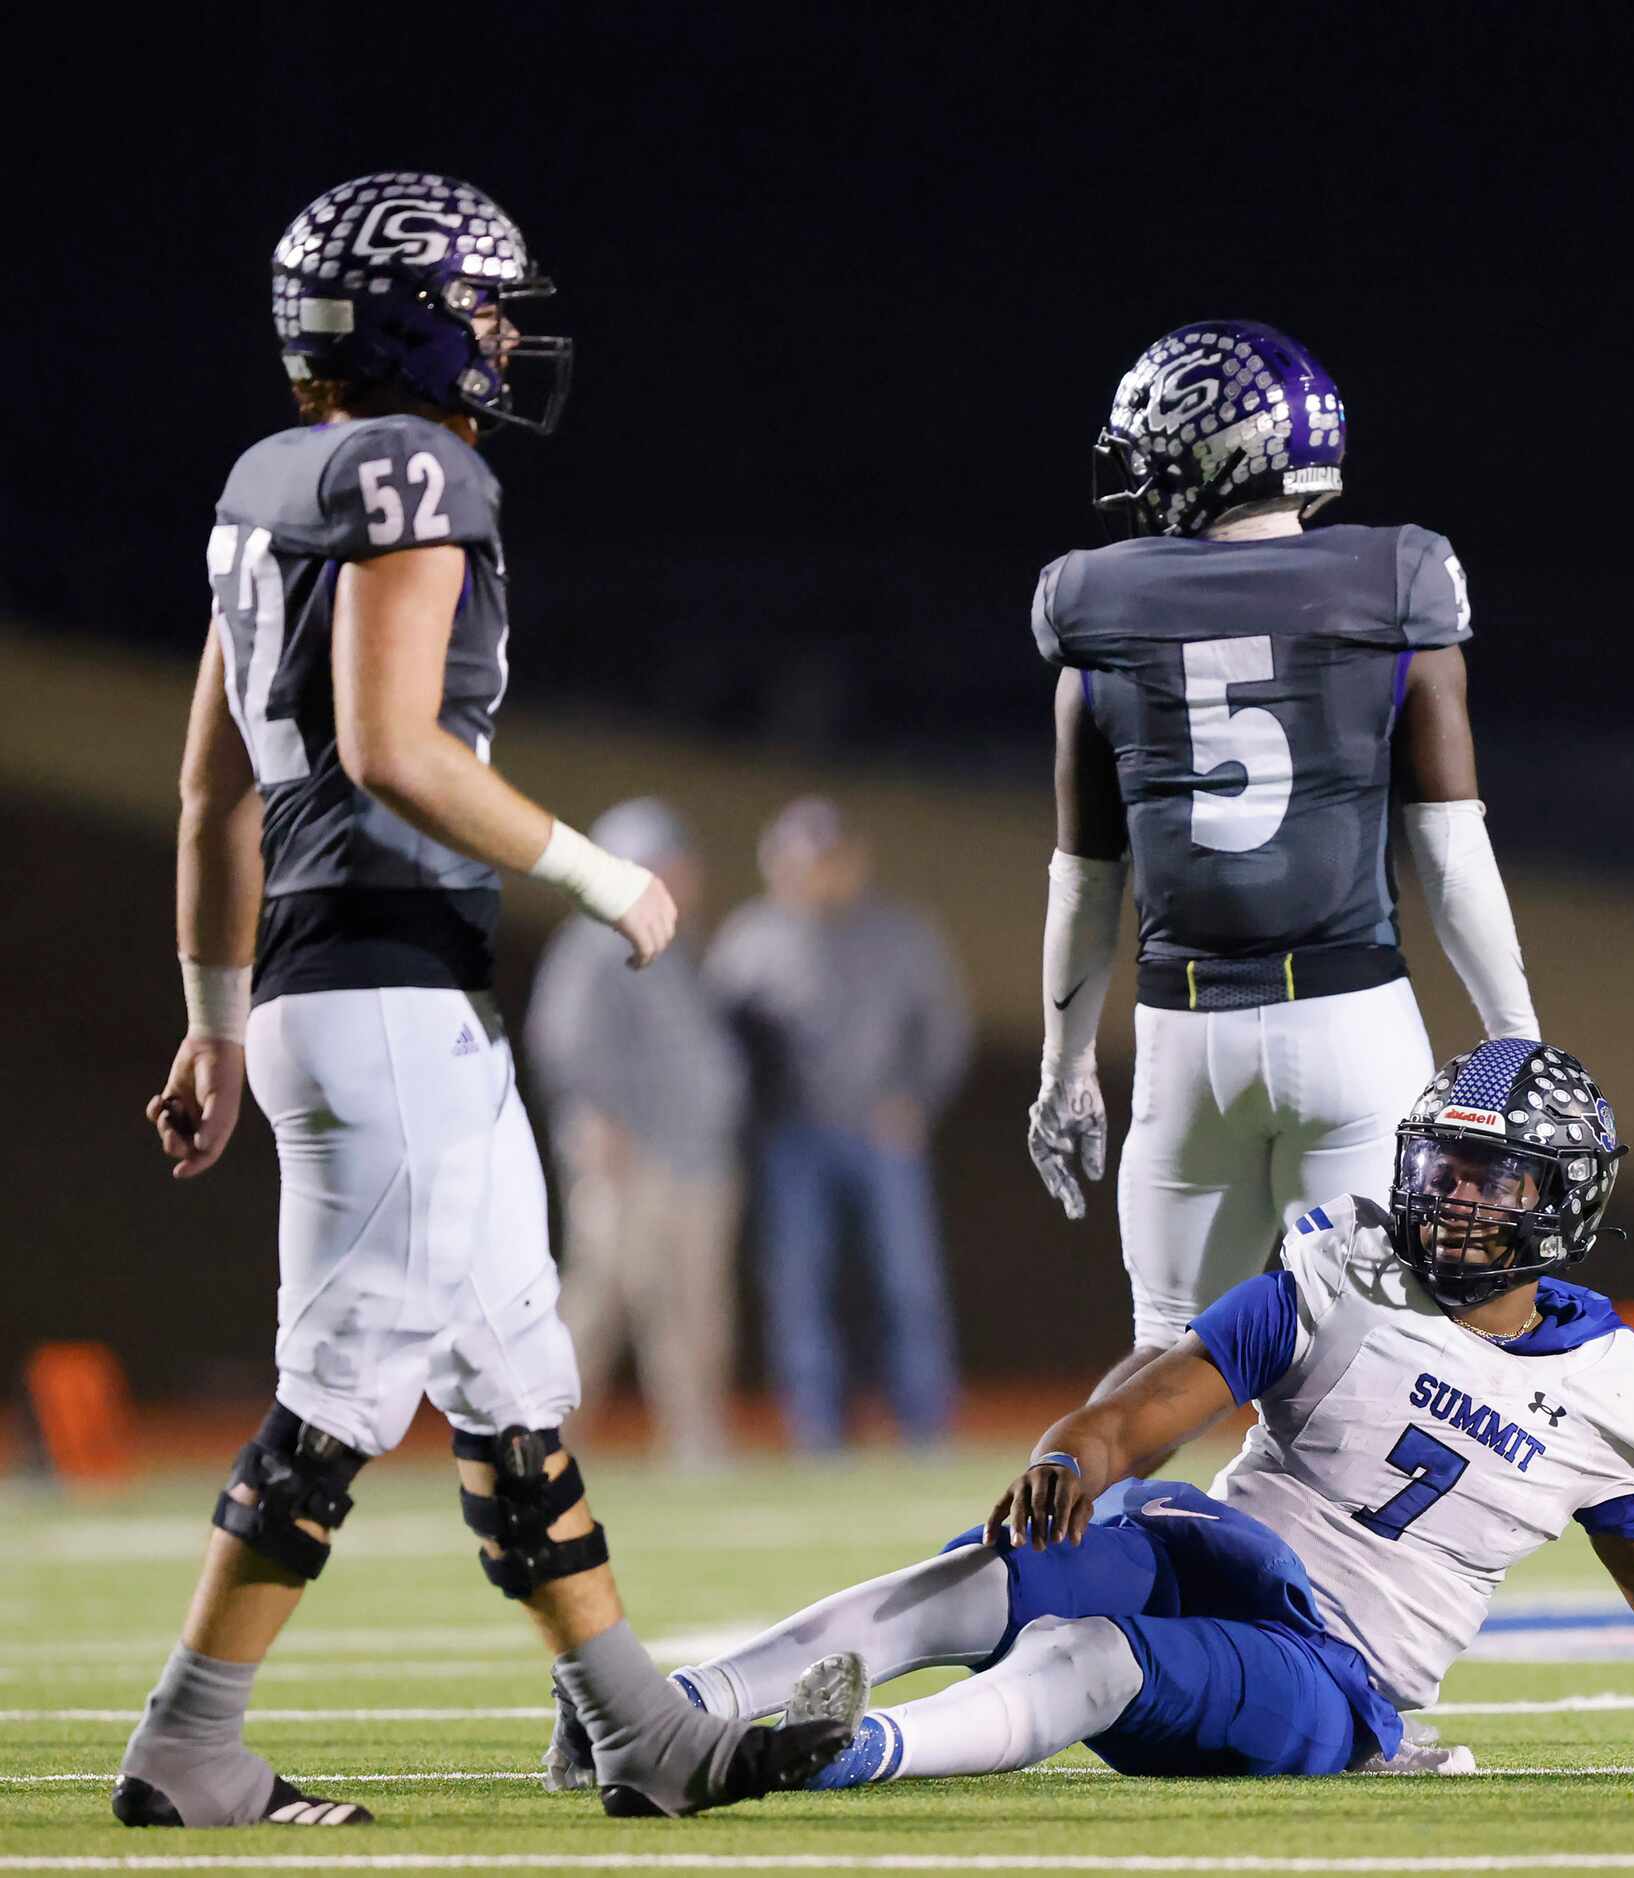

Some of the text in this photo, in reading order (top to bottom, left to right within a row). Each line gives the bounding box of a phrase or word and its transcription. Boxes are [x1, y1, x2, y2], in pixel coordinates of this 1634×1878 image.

[358, 451, 450, 545] 52
[1182, 634, 1293, 853] 5
[1409, 1372, 1547, 1473] SUMMIT
[1350, 1422, 1471, 1541] 7
